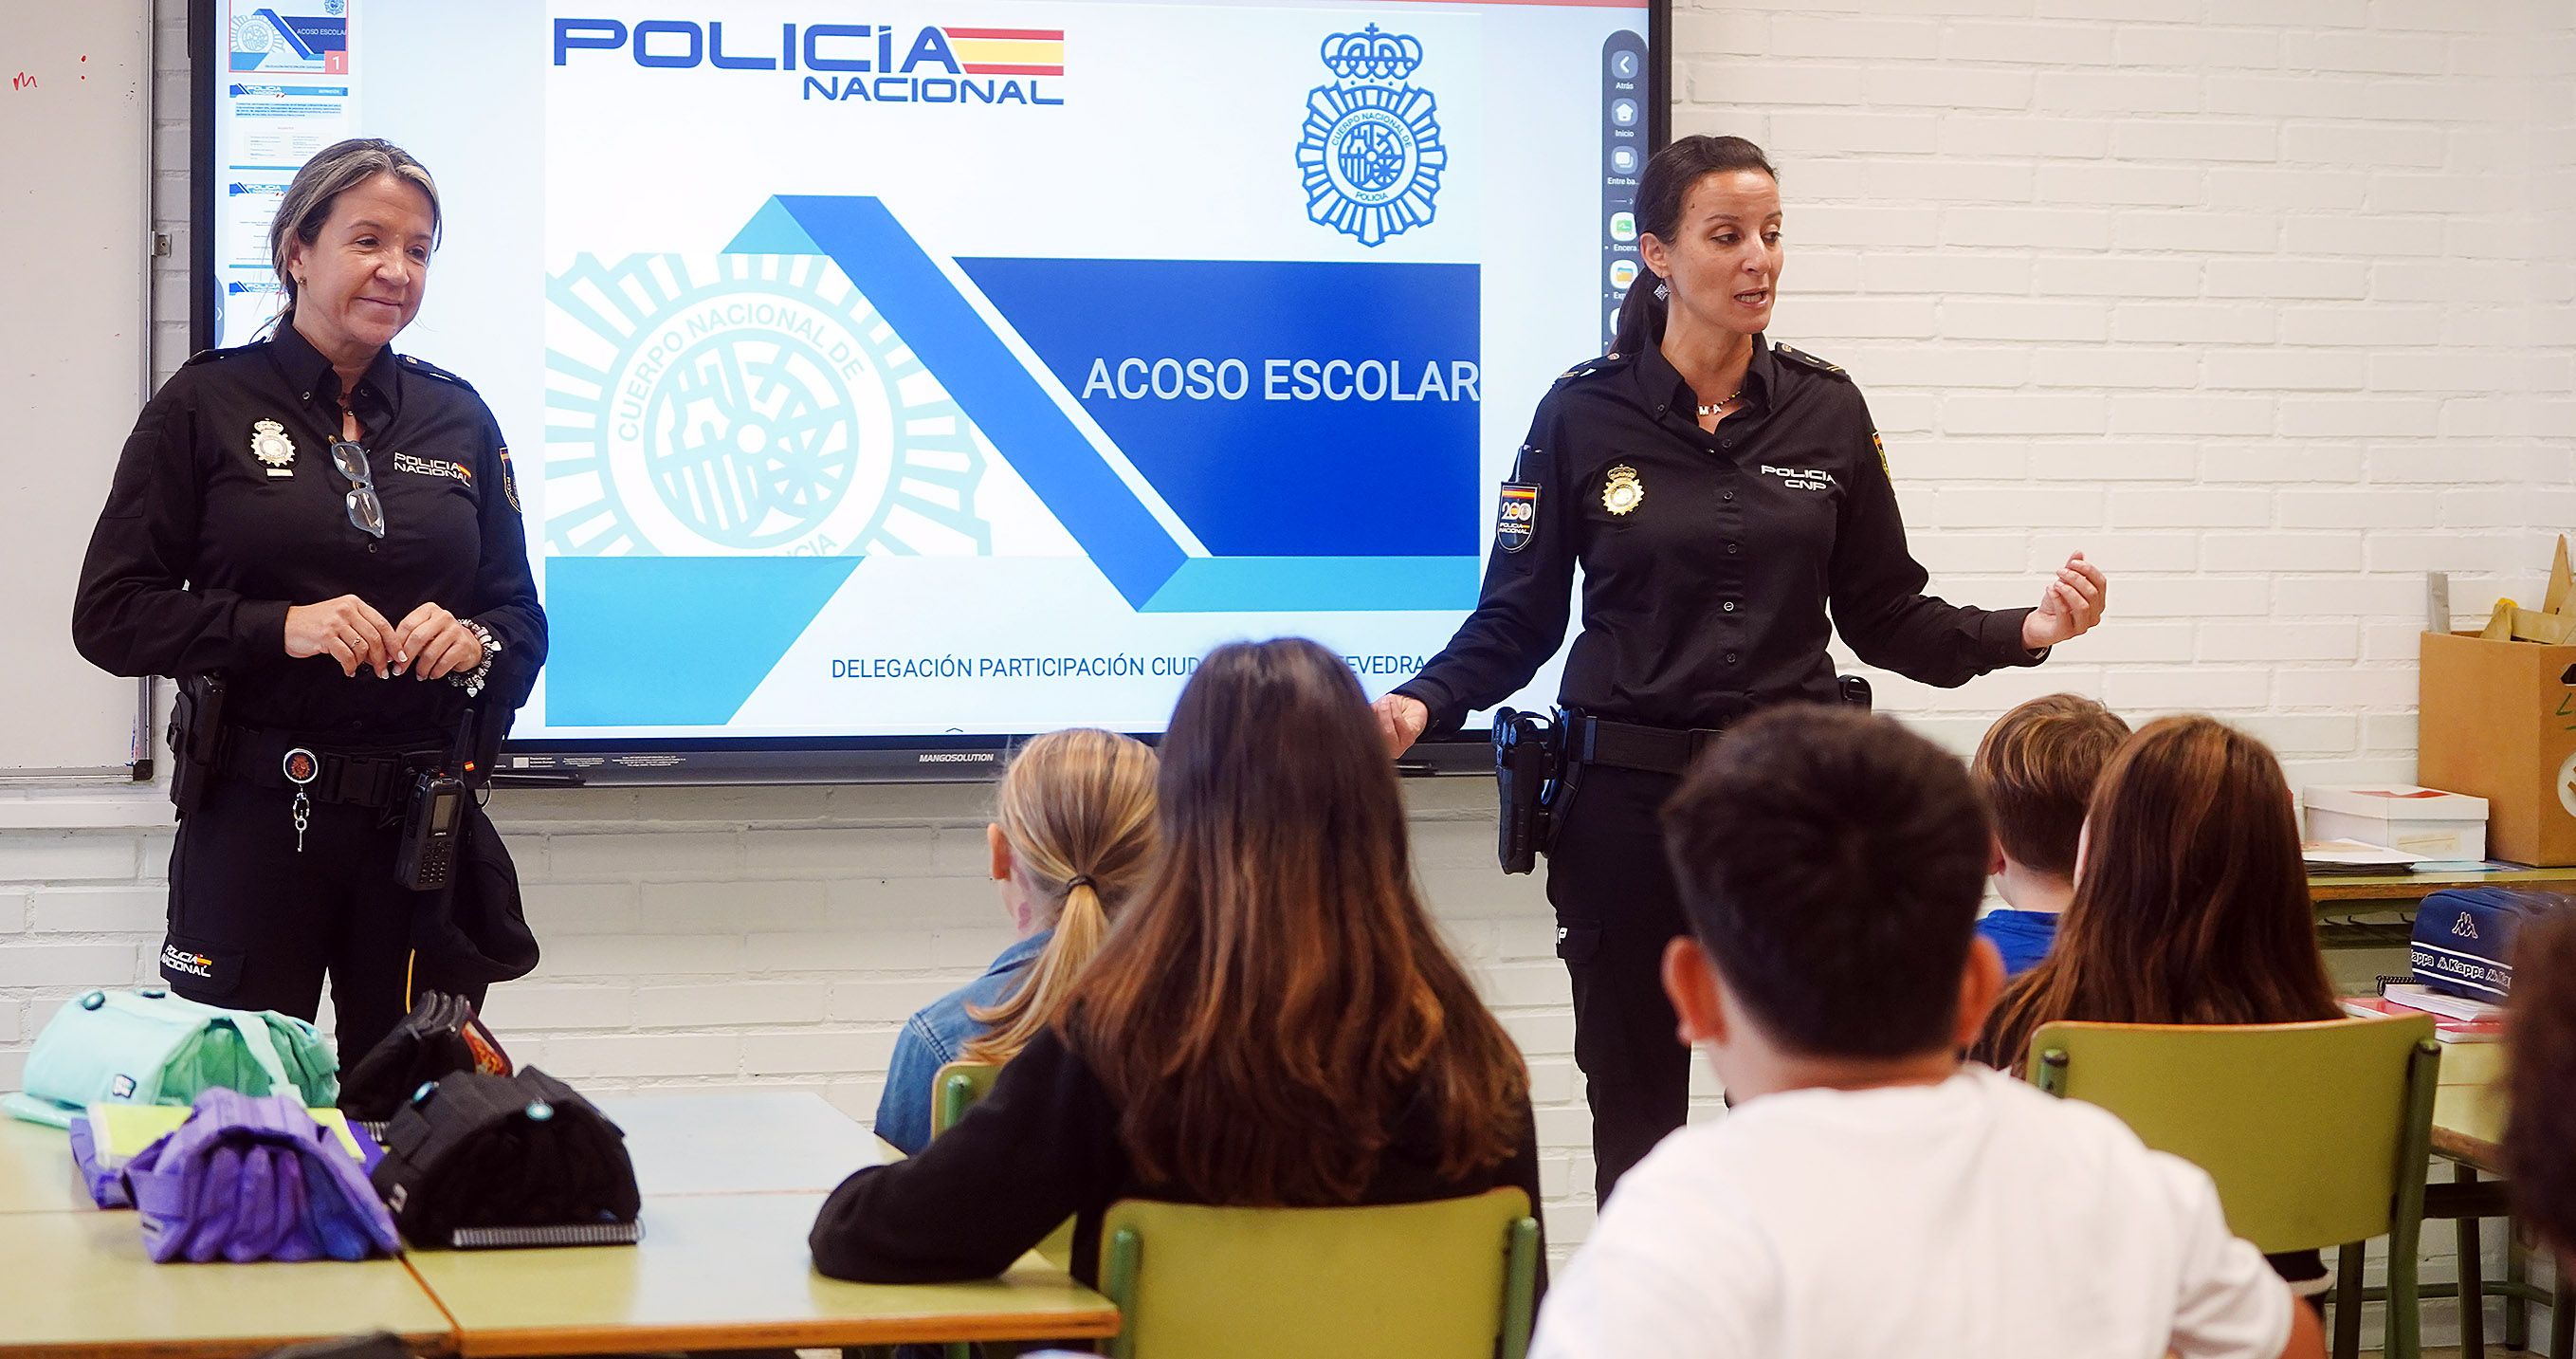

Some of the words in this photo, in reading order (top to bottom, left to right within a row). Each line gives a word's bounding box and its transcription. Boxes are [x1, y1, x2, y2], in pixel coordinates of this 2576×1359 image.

[333, 55, 340, 70] 1
[803, 76, 1064, 105] NACIONAL
[1616, 82, 1635, 90] Atrás
[1331, 115, 1361, 146] CUERPO
[1362, 112, 1403, 138] NACIONAL
[1403, 135, 1413, 148] DE
[1355, 191, 1389, 202] POLICIA
[1613, 291, 1626, 300] Exp
[618, 330, 684, 442] CUERPO
[685, 303, 827, 349] NACIONAL
[829, 341, 865, 381] DE
[1082, 357, 1250, 401] ACOSO
[1264, 358, 1481, 402] ESCOLAR
[394, 451, 460, 472] POLICIA
[393, 462, 471, 488] NACIONAL
[1761, 465, 1837, 486] POLICIA
[1784, 479, 1827, 491] CNP
[1501, 501, 1532, 522] 200
[831, 653, 973, 679] DELEGACIÓN
[979, 652, 1145, 678] PARTICIPACIÓN
[1151, 656, 1201, 676] CIUD
[1340, 655, 1426, 674] EVEDRA
[919, 753, 995, 762] MANGOSOLUTION
[2411, 949, 2435, 967] appa
[2448, 958, 2485, 979] Kappa
